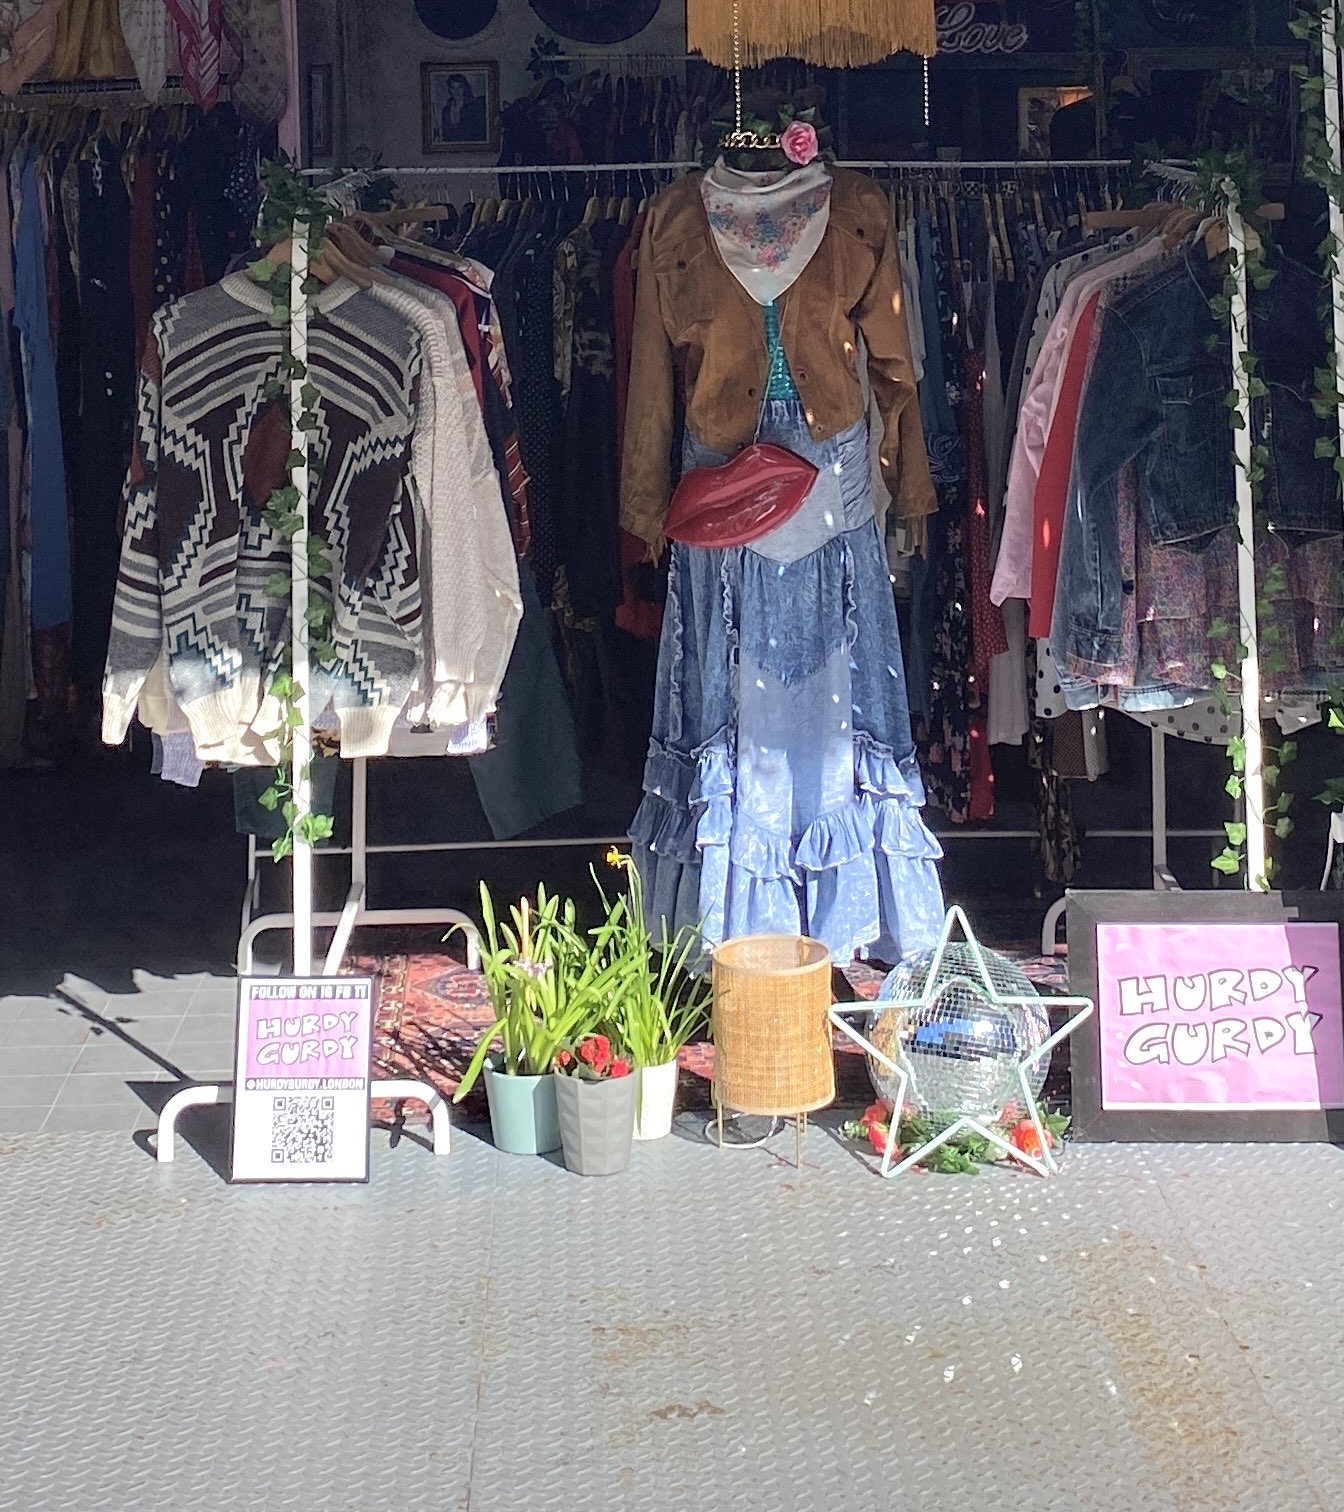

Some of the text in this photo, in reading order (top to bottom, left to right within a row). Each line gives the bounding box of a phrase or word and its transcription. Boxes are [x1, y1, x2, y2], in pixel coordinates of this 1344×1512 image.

[251, 984, 297, 1000] FOLLOW
[1118, 964, 1320, 1016] HURDY
[256, 1011, 359, 1040] HURDY
[1123, 1010, 1324, 1066] GURDY
[256, 1035, 359, 1066] GURDY
